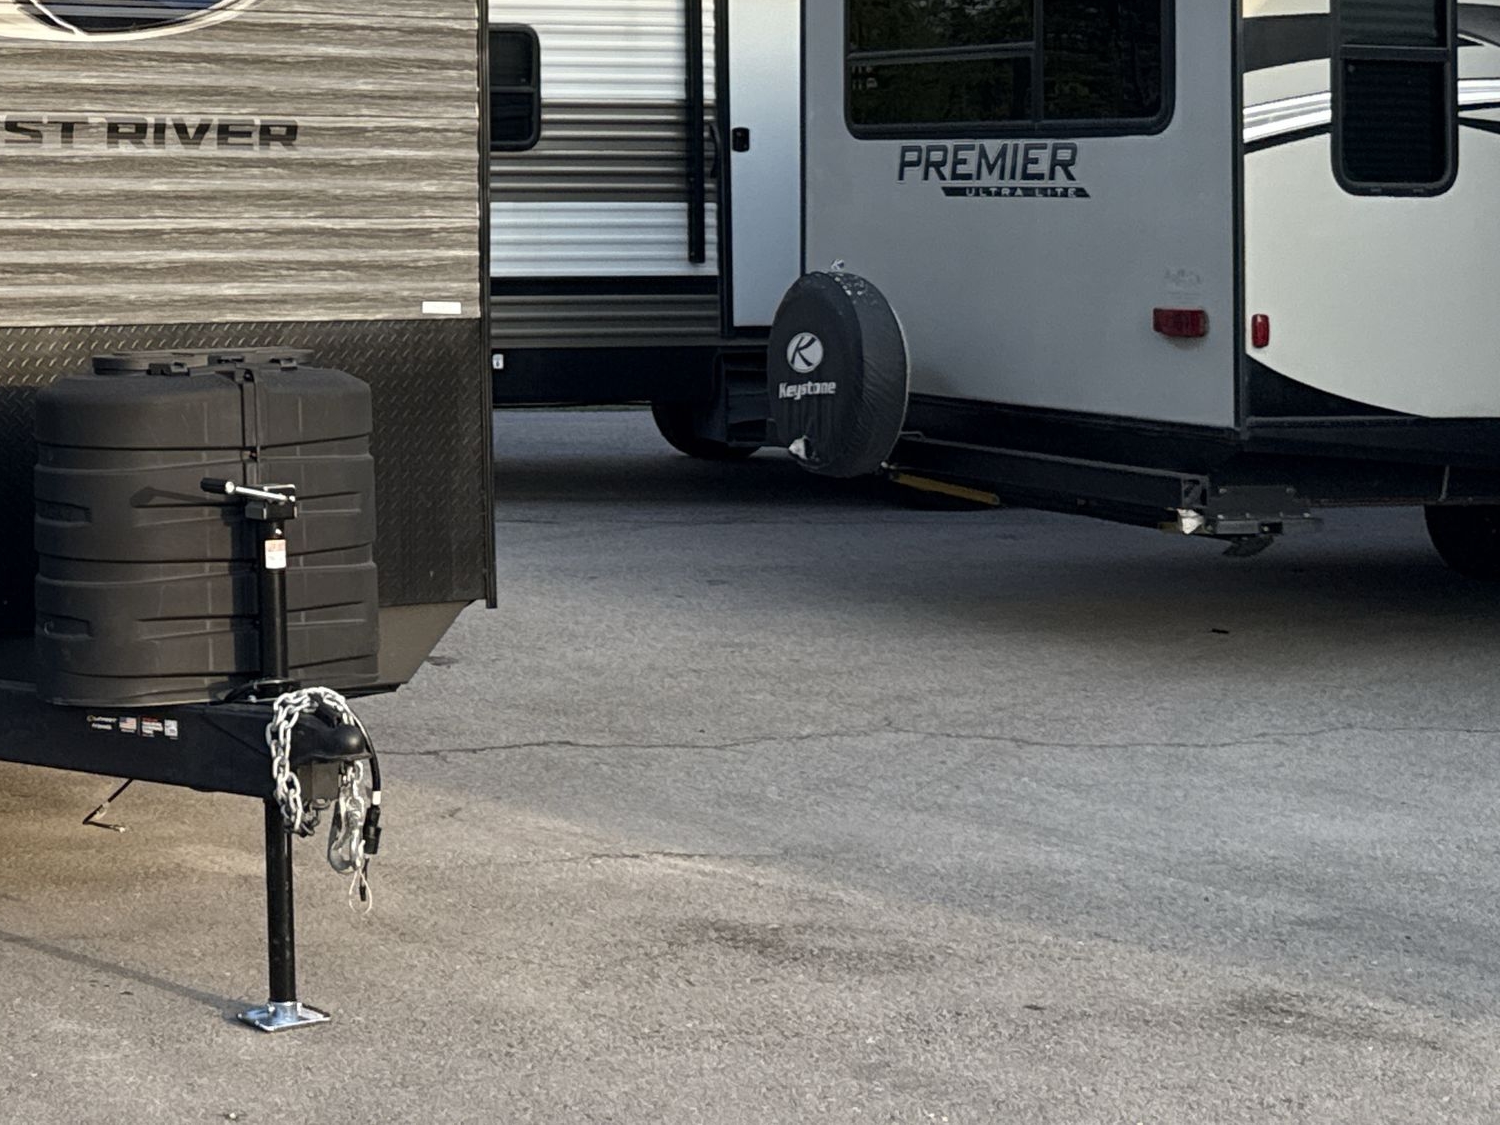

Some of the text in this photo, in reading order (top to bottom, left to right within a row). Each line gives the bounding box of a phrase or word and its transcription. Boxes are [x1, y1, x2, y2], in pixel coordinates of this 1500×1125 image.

[106, 118, 299, 151] RIVER
[897, 142, 1078, 182] PREMIER
[965, 187, 1077, 198] ULTRA LITE
[778, 380, 837, 401] Keystone
